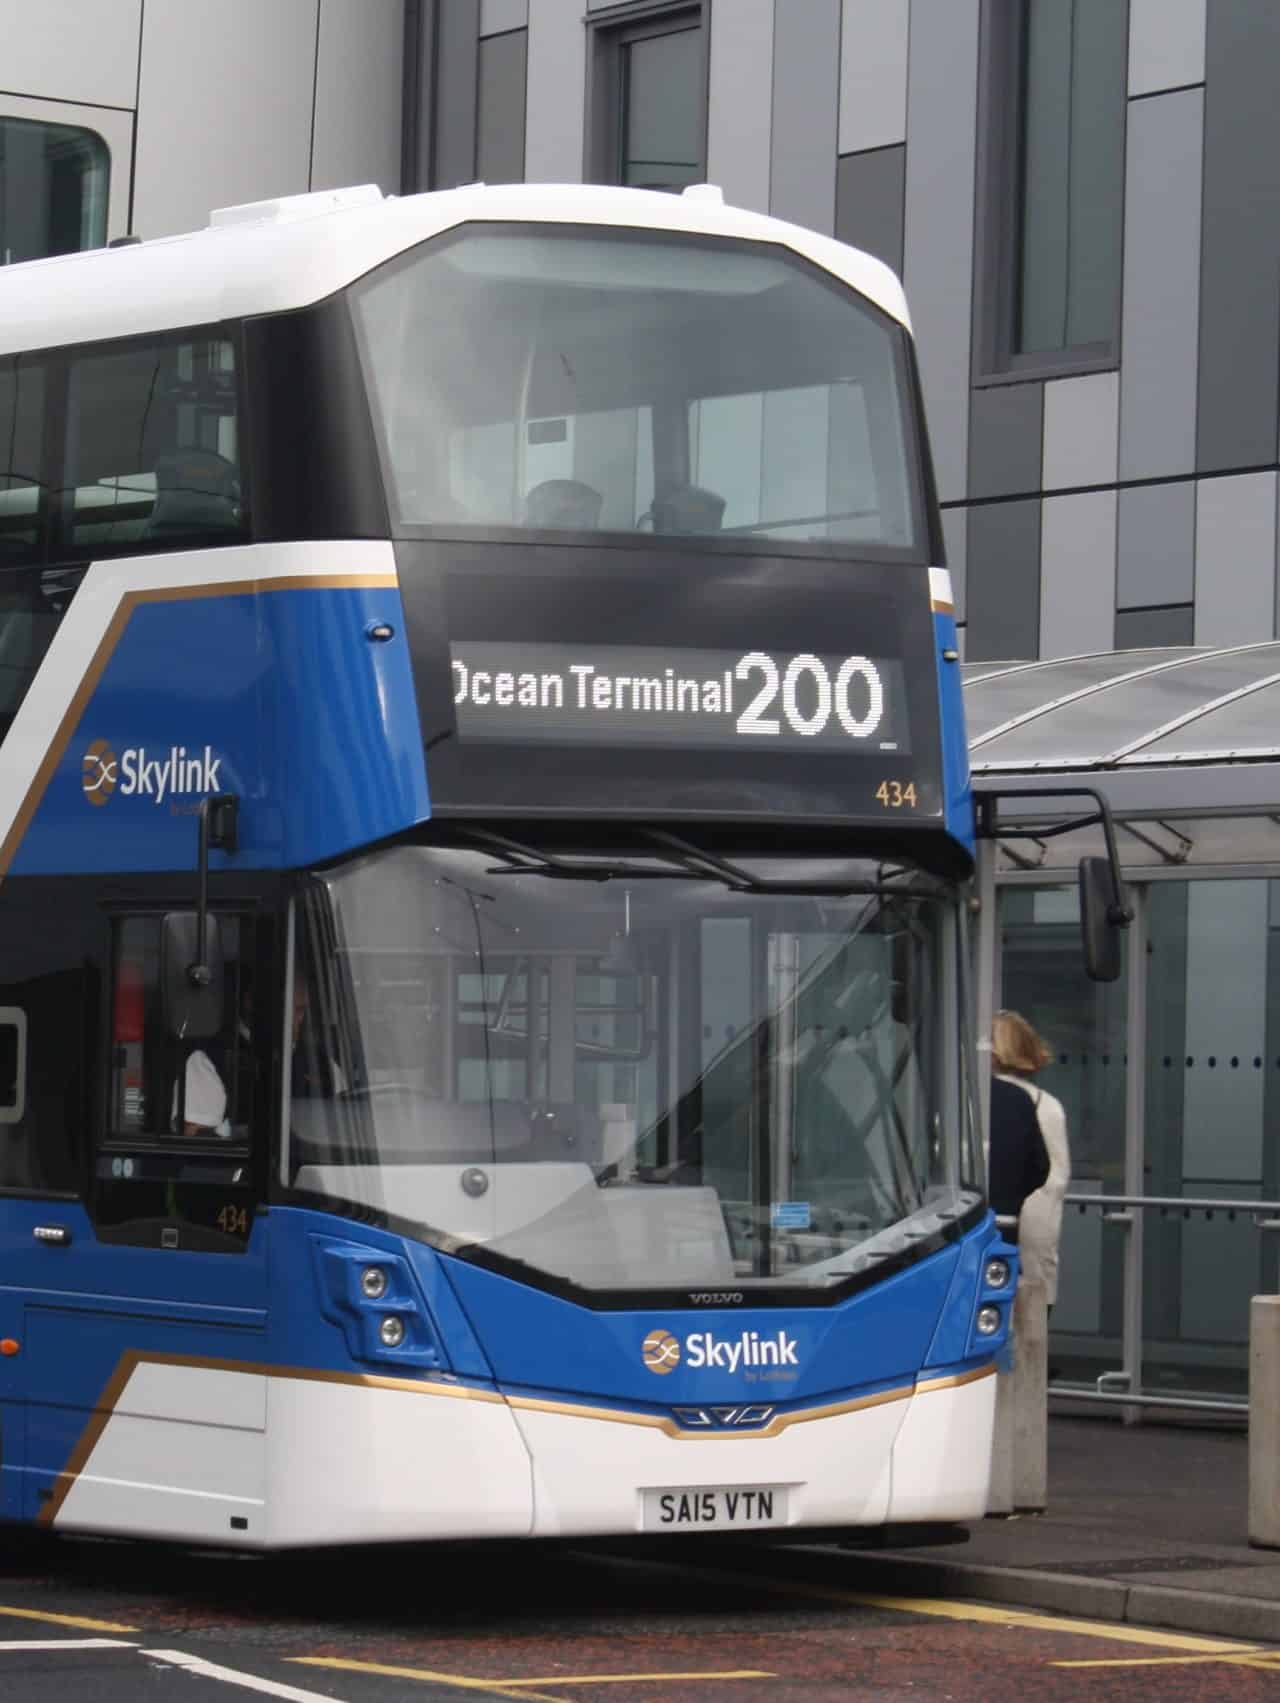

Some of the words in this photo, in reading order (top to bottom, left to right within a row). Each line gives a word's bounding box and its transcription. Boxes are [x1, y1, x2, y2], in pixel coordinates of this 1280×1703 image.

[569, 664, 733, 713] Terminal
[735, 651, 884, 738] 200
[120, 745, 221, 804] Skylink
[875, 781, 918, 809] 434
[217, 1205, 249, 1233] 434
[688, 1292, 744, 1304] VOLVO
[686, 1331, 799, 1373] Skylink
[660, 1493, 716, 1523] SA15
[724, 1490, 773, 1521] VTN
